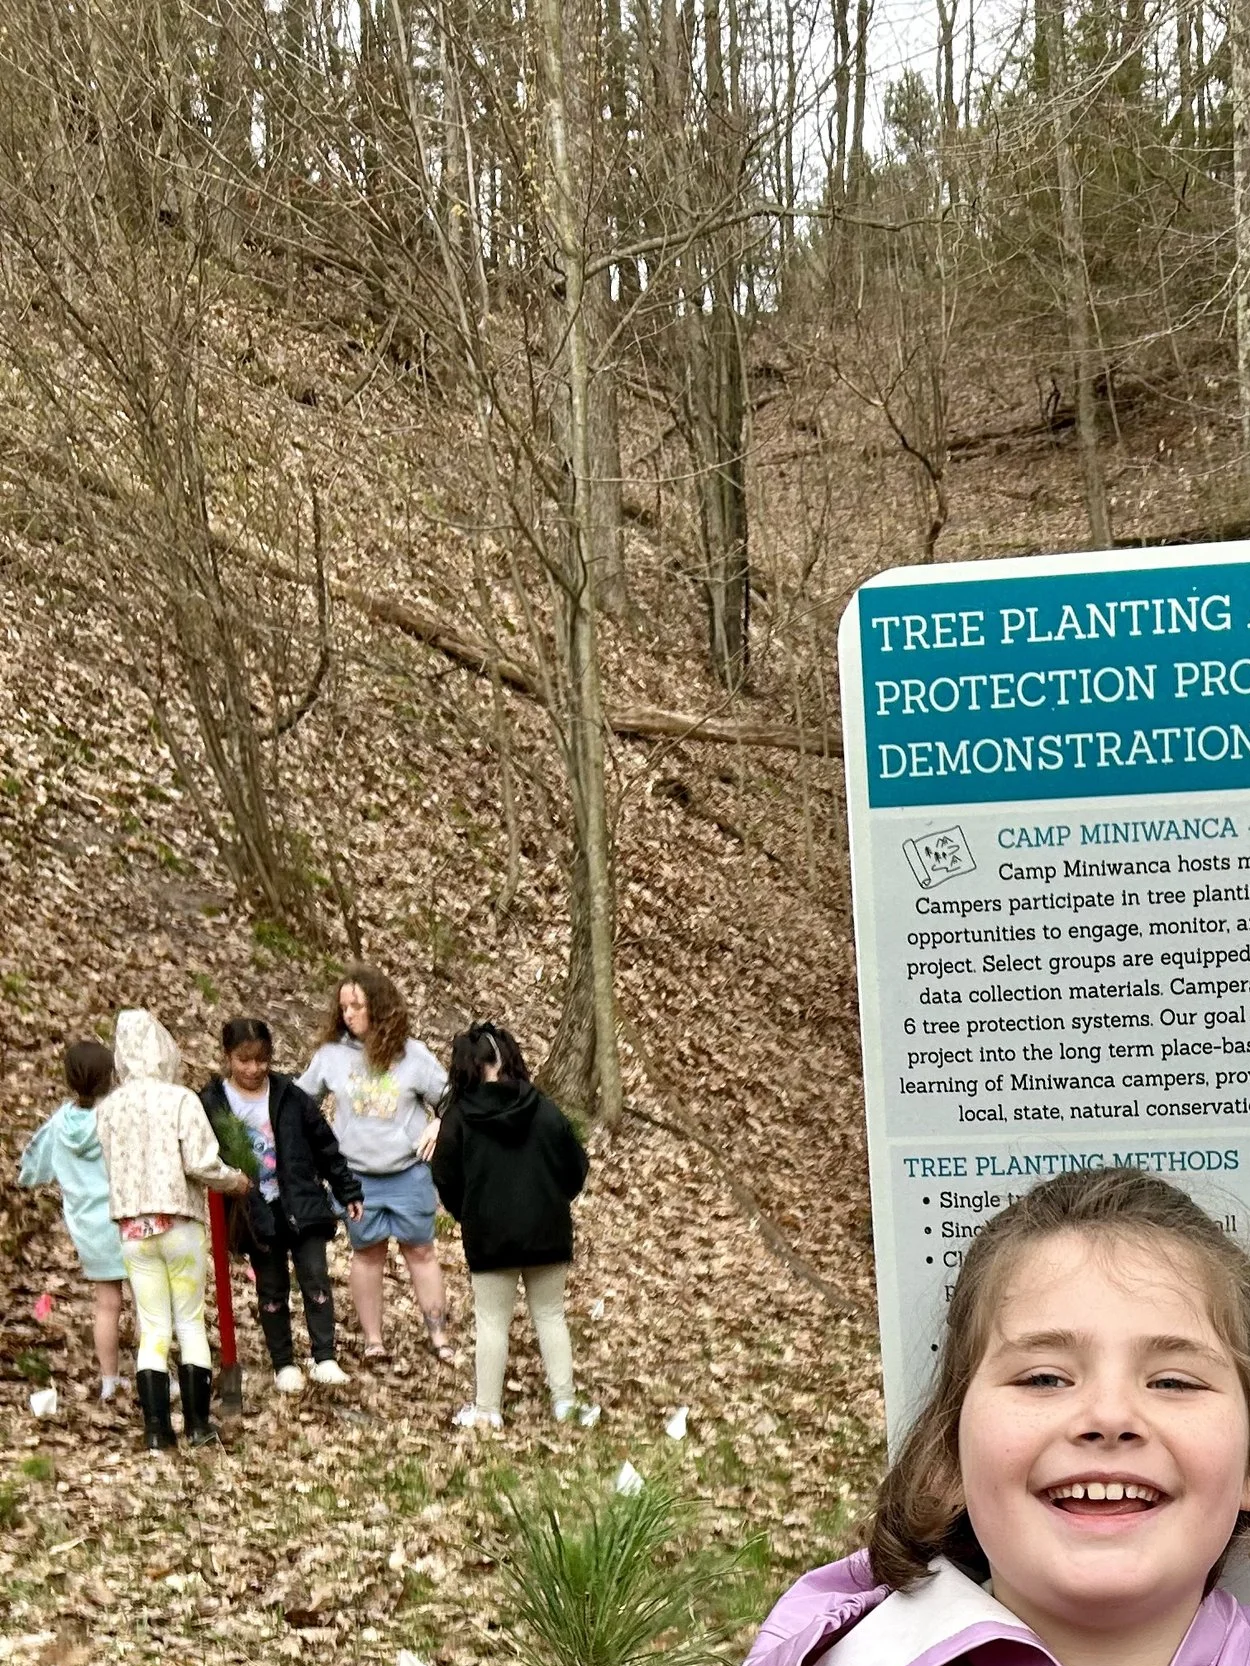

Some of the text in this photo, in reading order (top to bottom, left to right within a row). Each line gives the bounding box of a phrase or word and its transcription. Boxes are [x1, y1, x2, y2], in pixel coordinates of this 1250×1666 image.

[872, 611, 985, 652] TREE
[1000, 595, 1231, 644] PLANTING
[875, 664, 1157, 715] PROTECTION
[998, 825, 1071, 849] CAMP
[1080, 816, 1239, 845] MINIWANCA
[998, 862, 1056, 884] Camp
[1063, 859, 1171, 878] Miniwanca
[1177, 854, 1231, 873] hosts
[915, 897, 1002, 918] Campers
[1008, 892, 1115, 916] participate
[1121, 889, 1140, 906] in
[1147, 889, 1186, 905] tree
[907, 925, 1036, 950] opportunities
[1042, 924, 1061, 940] to
[1068, 923, 1143, 943] engage,
[1149, 917, 1230, 935] monitor,
[906, 958, 976, 980] project.
[982, 954, 1043, 973] Select
[1049, 955, 1116, 975] groups
[1122, 953, 1154, 967] are
[919, 987, 963, 1005] data
[969, 984, 1062, 1003] collection
[1069, 978, 1164, 1000] materials.
[904, 1017, 916, 1035] 6
[922, 1019, 960, 1034] tree
[966, 1014, 1065, 1038] protection
[1071, 1013, 1154, 1034] systems.
[1160, 1008, 1198, 1026] Our
[1204, 1005, 1246, 1030] goal
[907, 1047, 974, 1069] project
[979, 1046, 1016, 1062] into
[1022, 1043, 1053, 1061] the
[1059, 1042, 1101, 1064] long
[1108, 1043, 1155, 1058] term
[899, 1077, 978, 1098] learning
[985, 1074, 1004, 1092] of
[1010, 1073, 1116, 1091] Miniwanca
[1122, 1072, 1209, 1091] campers,
[958, 1104, 1008, 1123] local,
[1013, 1105, 1064, 1122] state,
[1070, 1099, 1140, 1119] natural
[903, 1149, 1241, 1177] TREE PLANTING METHODS
[940, 1190, 1001, 1213] Single
